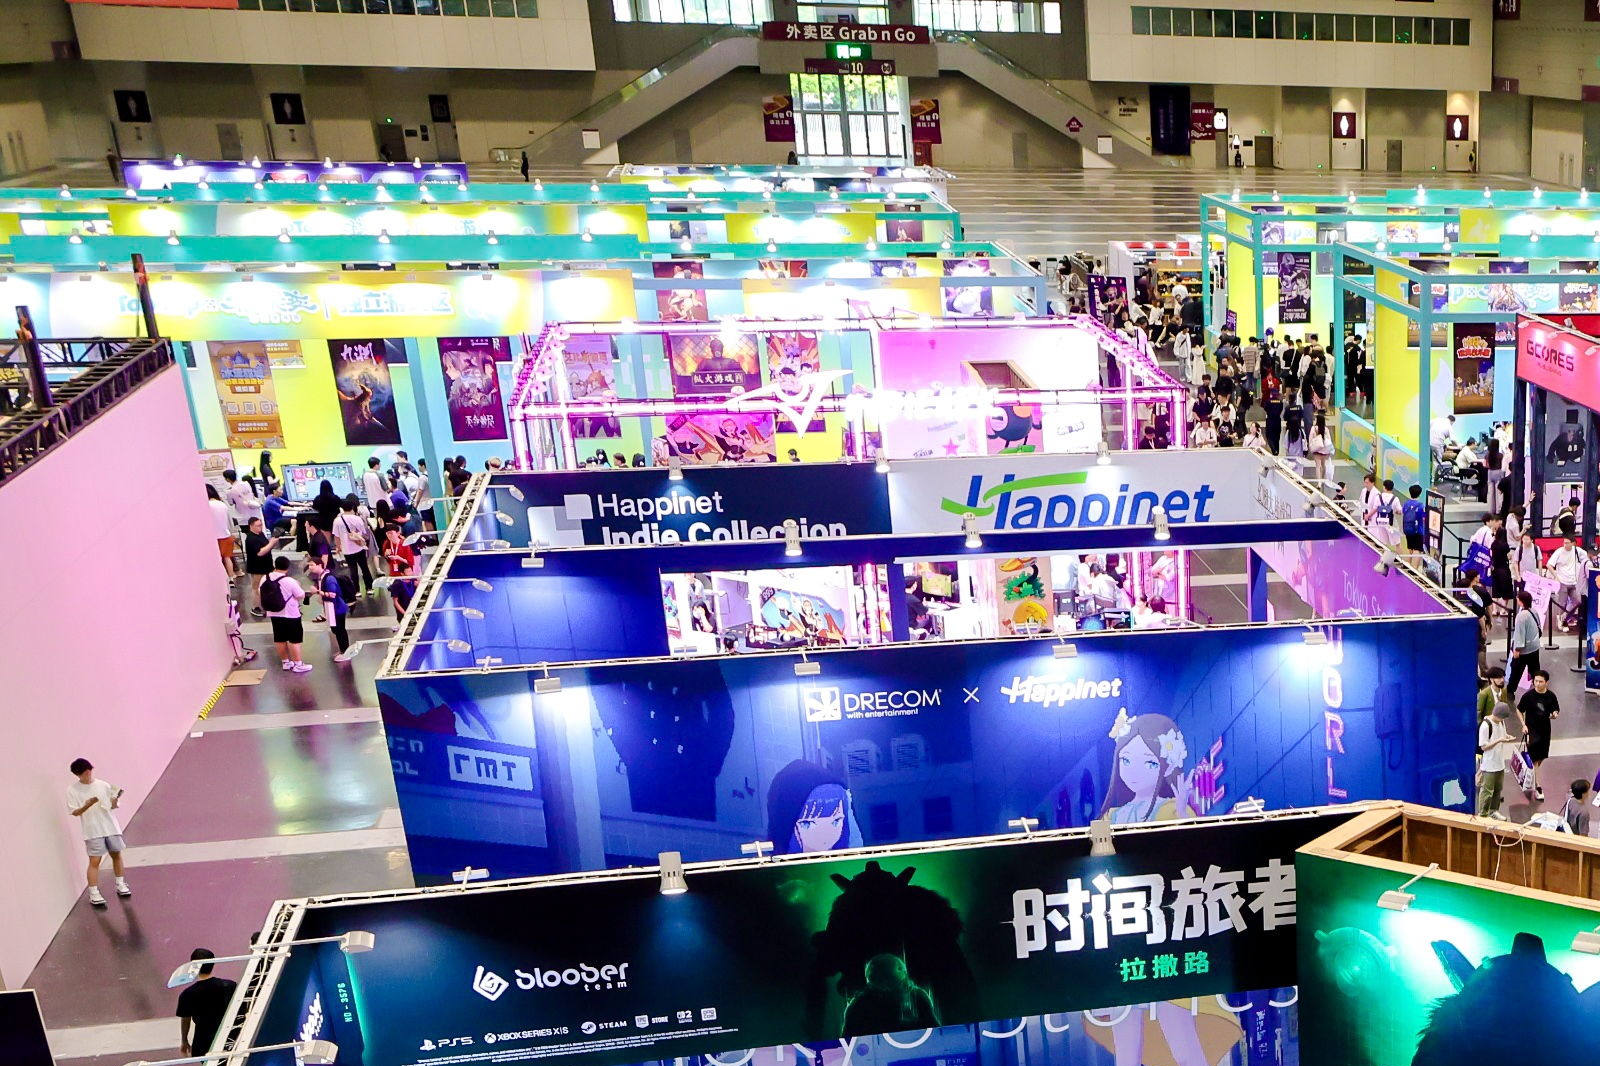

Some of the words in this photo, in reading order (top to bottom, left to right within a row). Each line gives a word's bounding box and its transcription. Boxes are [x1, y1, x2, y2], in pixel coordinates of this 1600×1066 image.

[786, 24, 836, 40] 外卖区
[838, 26, 878, 41] Grab
[881, 30, 891, 41] n
[894, 28, 916, 42] Go
[851, 62, 864, 74] 10
[1525, 339, 1575, 373] GCORES
[597, 490, 724, 522] Happinet
[940, 471, 1216, 531] Happinet
[602, 523, 680, 546] Indie
[689, 519, 847, 543] Collecion
[1342, 570, 1369, 615] Tokyo
[844, 689, 941, 712] DRECOM
[1001, 674, 1123, 706] Happinet
[846, 709, 864, 720] with
[865, 707, 919, 719] entertainment
[1012, 859, 1297, 959] 时间旅者
[514, 962, 629, 991] bloober
[1119, 951, 1210, 983] 拉撒路
[583, 980, 628, 992] team
[437, 1037, 474, 1048] PS5
[497, 1031, 521, 1042] XBOX
[521, 1028, 552, 1039] SERIES
[598, 1020, 628, 1030] STEAM
